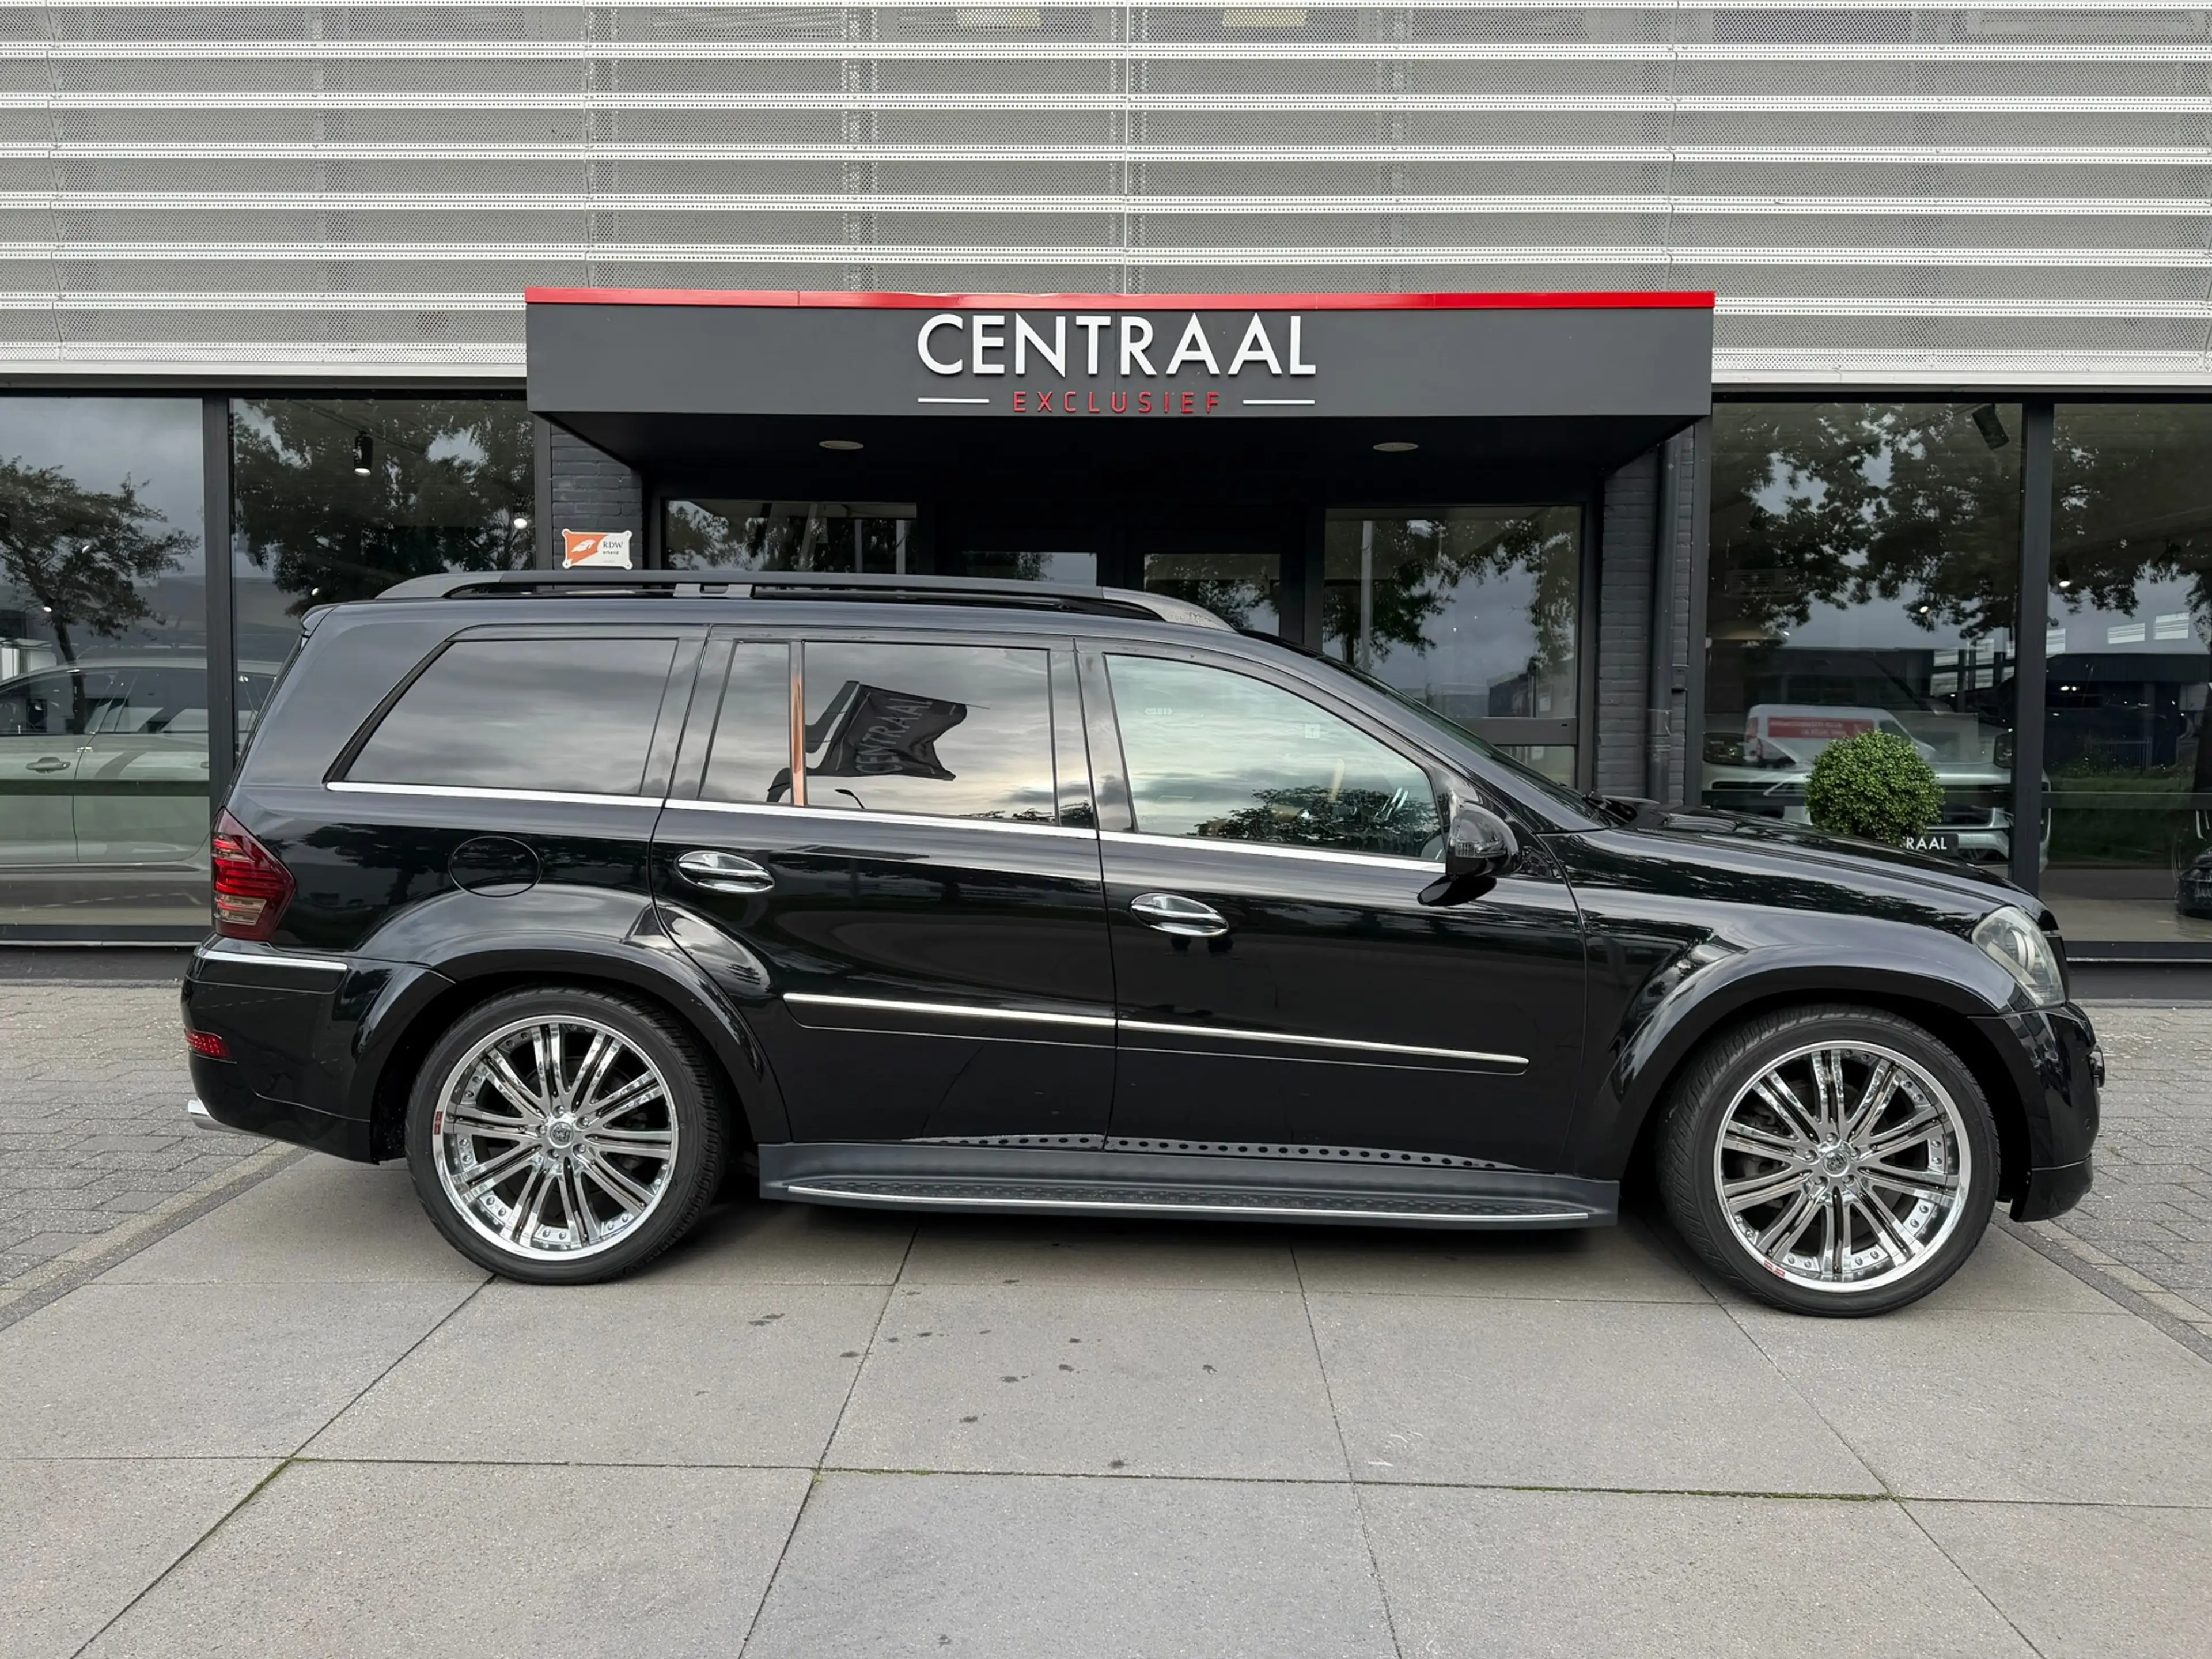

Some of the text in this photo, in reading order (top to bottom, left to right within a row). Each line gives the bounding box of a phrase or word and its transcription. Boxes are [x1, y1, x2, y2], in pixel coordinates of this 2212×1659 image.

[917, 312, 1316, 378] CENTRAAL
[1013, 391, 1221, 413] EXCLUSIEF
[855, 698, 933, 774] CENTRAAL
[1904, 836, 1947, 850] RAAL
